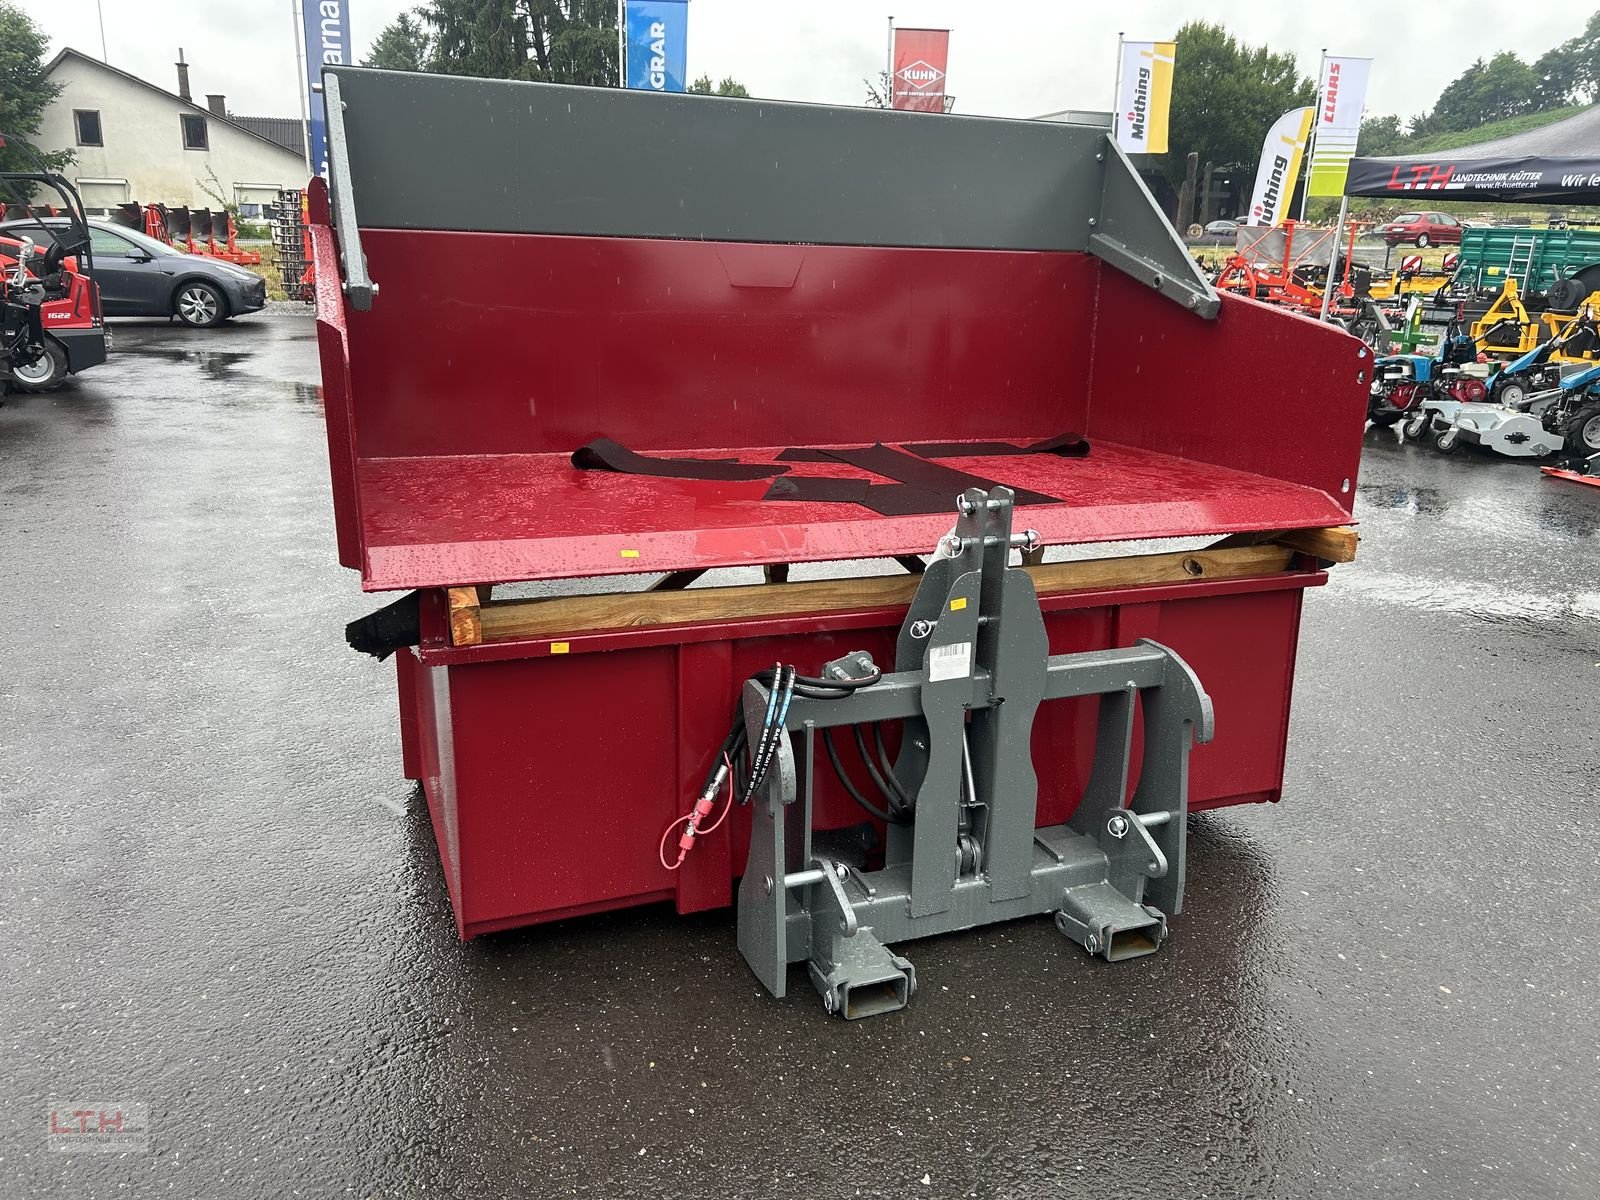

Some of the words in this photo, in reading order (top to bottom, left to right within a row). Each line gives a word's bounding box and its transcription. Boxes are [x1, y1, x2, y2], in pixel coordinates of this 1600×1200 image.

[650, 22, 665, 91] GRAR
[903, 69, 937, 80] KUHN
[1127, 67, 1150, 141] Müthing
[1324, 62, 1341, 123] CLAAS
[1386, 164, 1456, 191] LTH
[1451, 173, 1508, 183] LANDTECHNIK
[1509, 169, 1544, 181] HÜTTER
[1561, 173, 1587, 187] Wir
